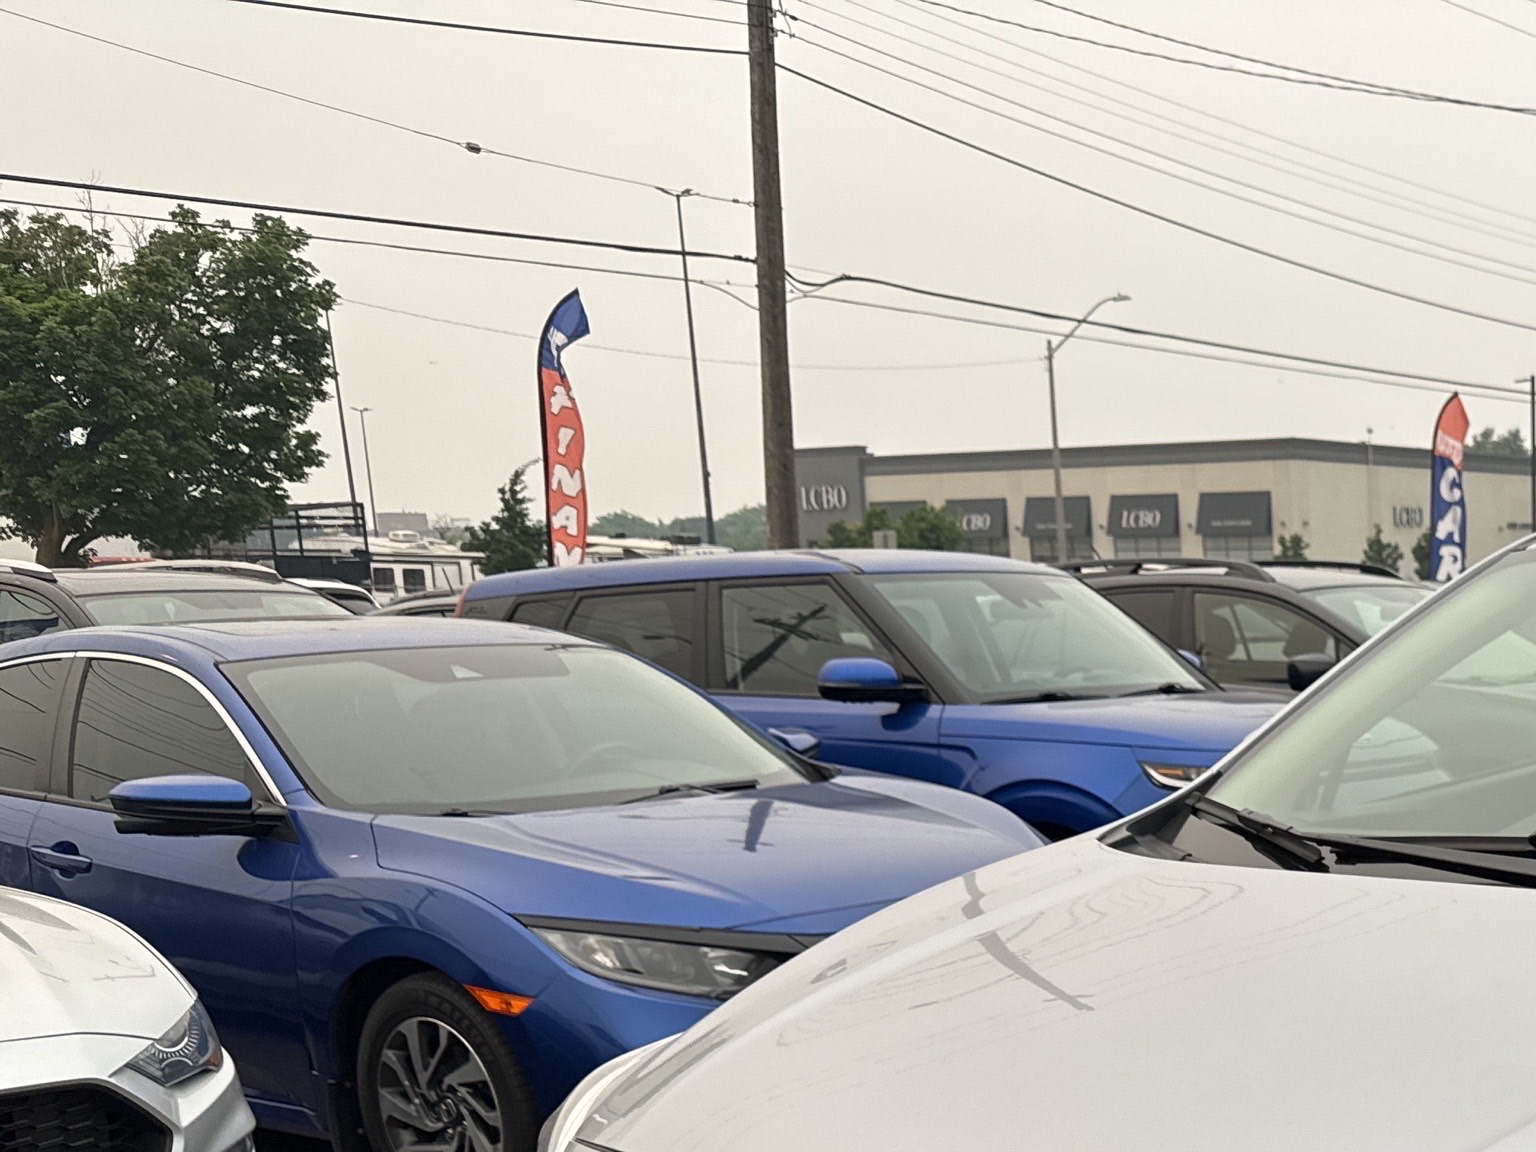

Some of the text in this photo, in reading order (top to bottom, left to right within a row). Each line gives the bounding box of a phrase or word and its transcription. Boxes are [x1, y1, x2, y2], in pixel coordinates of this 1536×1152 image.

[801, 484, 847, 511] LCBO
[957, 513, 990, 532] CBO
[1121, 509, 1161, 528] LCBO
